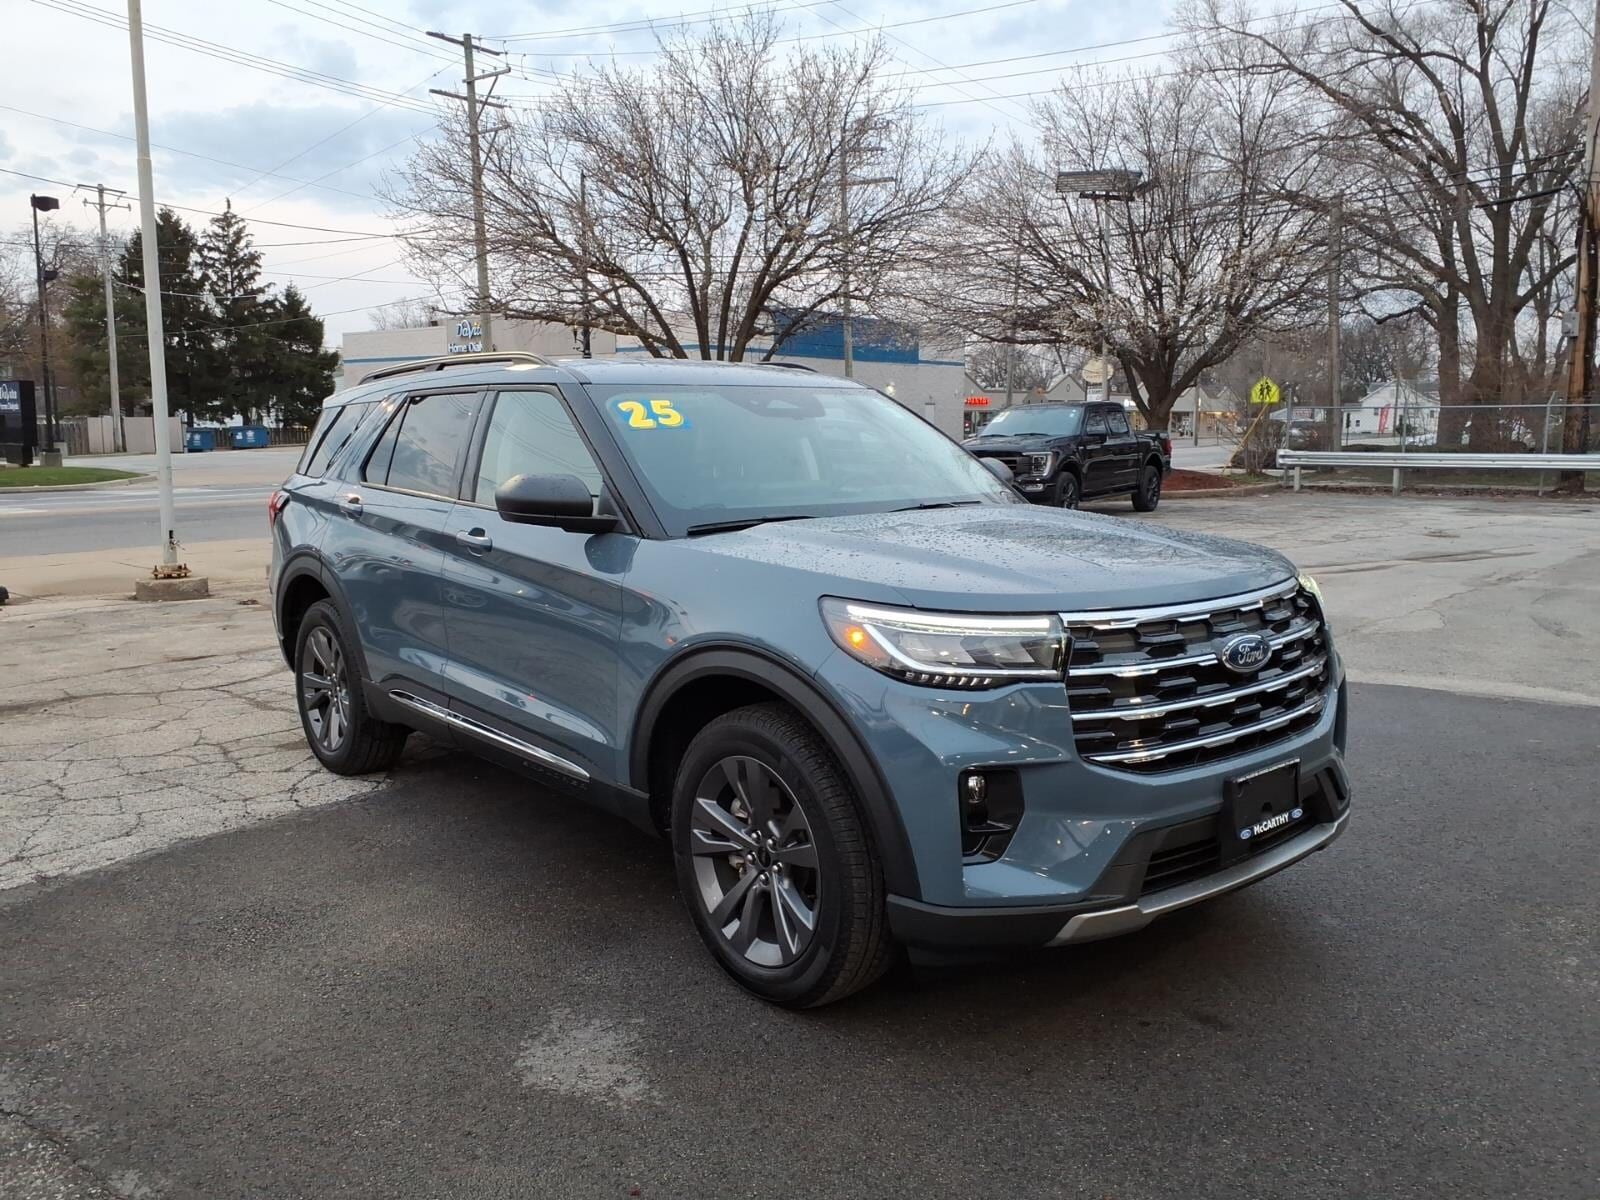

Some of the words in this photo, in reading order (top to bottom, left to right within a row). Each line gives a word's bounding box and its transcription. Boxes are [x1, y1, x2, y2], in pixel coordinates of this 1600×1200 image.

[456, 319, 481, 339] DaVit
[448, 342, 468, 353] Home
[617, 399, 684, 430] 25
[1238, 642, 1264, 664] Ford
[1253, 812, 1289, 835] McCARTHY
